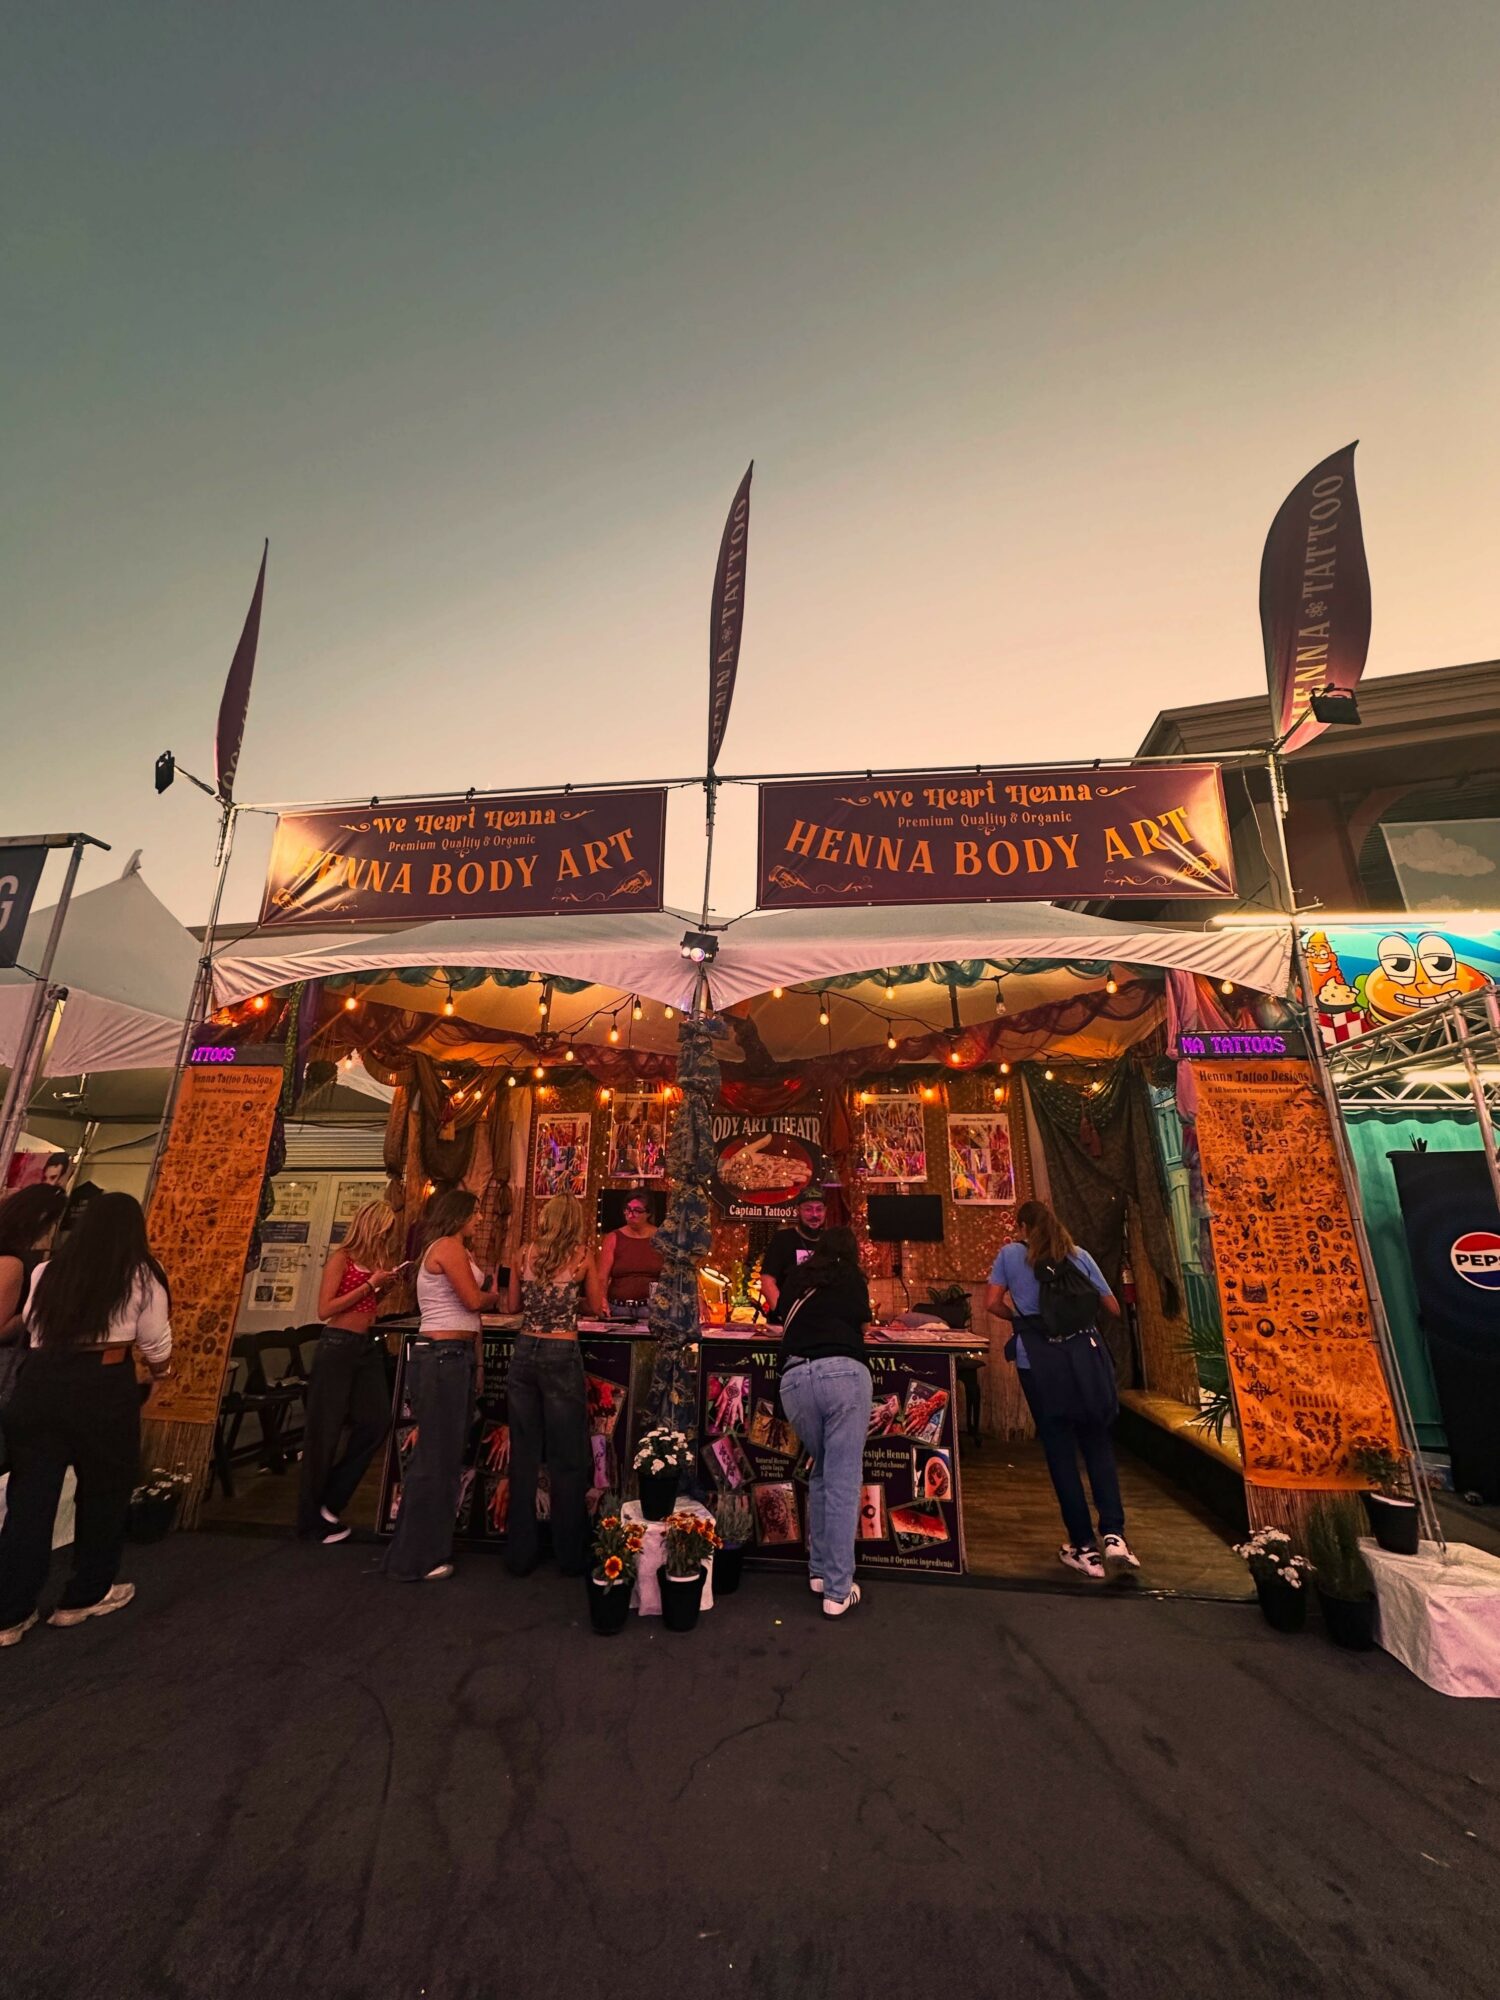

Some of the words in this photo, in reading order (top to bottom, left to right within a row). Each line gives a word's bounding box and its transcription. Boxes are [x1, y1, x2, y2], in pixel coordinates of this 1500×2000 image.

[1302, 474, 1343, 600] TATTOO
[721, 498, 747, 627] TATTOO
[872, 789, 914, 809] We
[922, 779, 997, 811] Heart
[1004, 783, 1093, 808] Henna
[372, 816, 407, 835] We
[414, 805, 475, 836] Heart
[483, 808, 557, 832] Henna
[897, 815, 954, 829] Premium
[960, 811, 1008, 828] Quality
[1009, 811, 1019, 824] &
[1021, 810, 1073, 827] Organic
[388, 840, 436, 853] Premium
[441, 835, 481, 850] Quality
[482, 835, 491, 847] &
[492, 833, 537, 849] Organic
[784, 817, 935, 876] HENNA
[953, 832, 1080, 877] BODY
[1103, 804, 1195, 864] ART
[427, 854, 539, 897] BODY
[556, 827, 636, 882] ART
[1210, 1035, 1287, 1054] TATTOOS
[217, 1073, 241, 1086] Tattoo
[242, 1074, 273, 1088] Designs
[1199, 1070, 1233, 1082] Henna
[1235, 1070, 1269, 1084] Tattoo
[1271, 1069, 1310, 1085] Designs
[742, 1116, 768, 1134] ART
[729, 1203, 763, 1218] Captain
[763, 1205, 798, 1217] Tattoo's
[1455, 1254, 1500, 1267] PEP
[751, 1352, 778, 1367] WE
[886, 1448, 910, 1460] Henna
[861, 1553, 890, 1564] Premium
[895, 1555, 919, 1567] Organic
